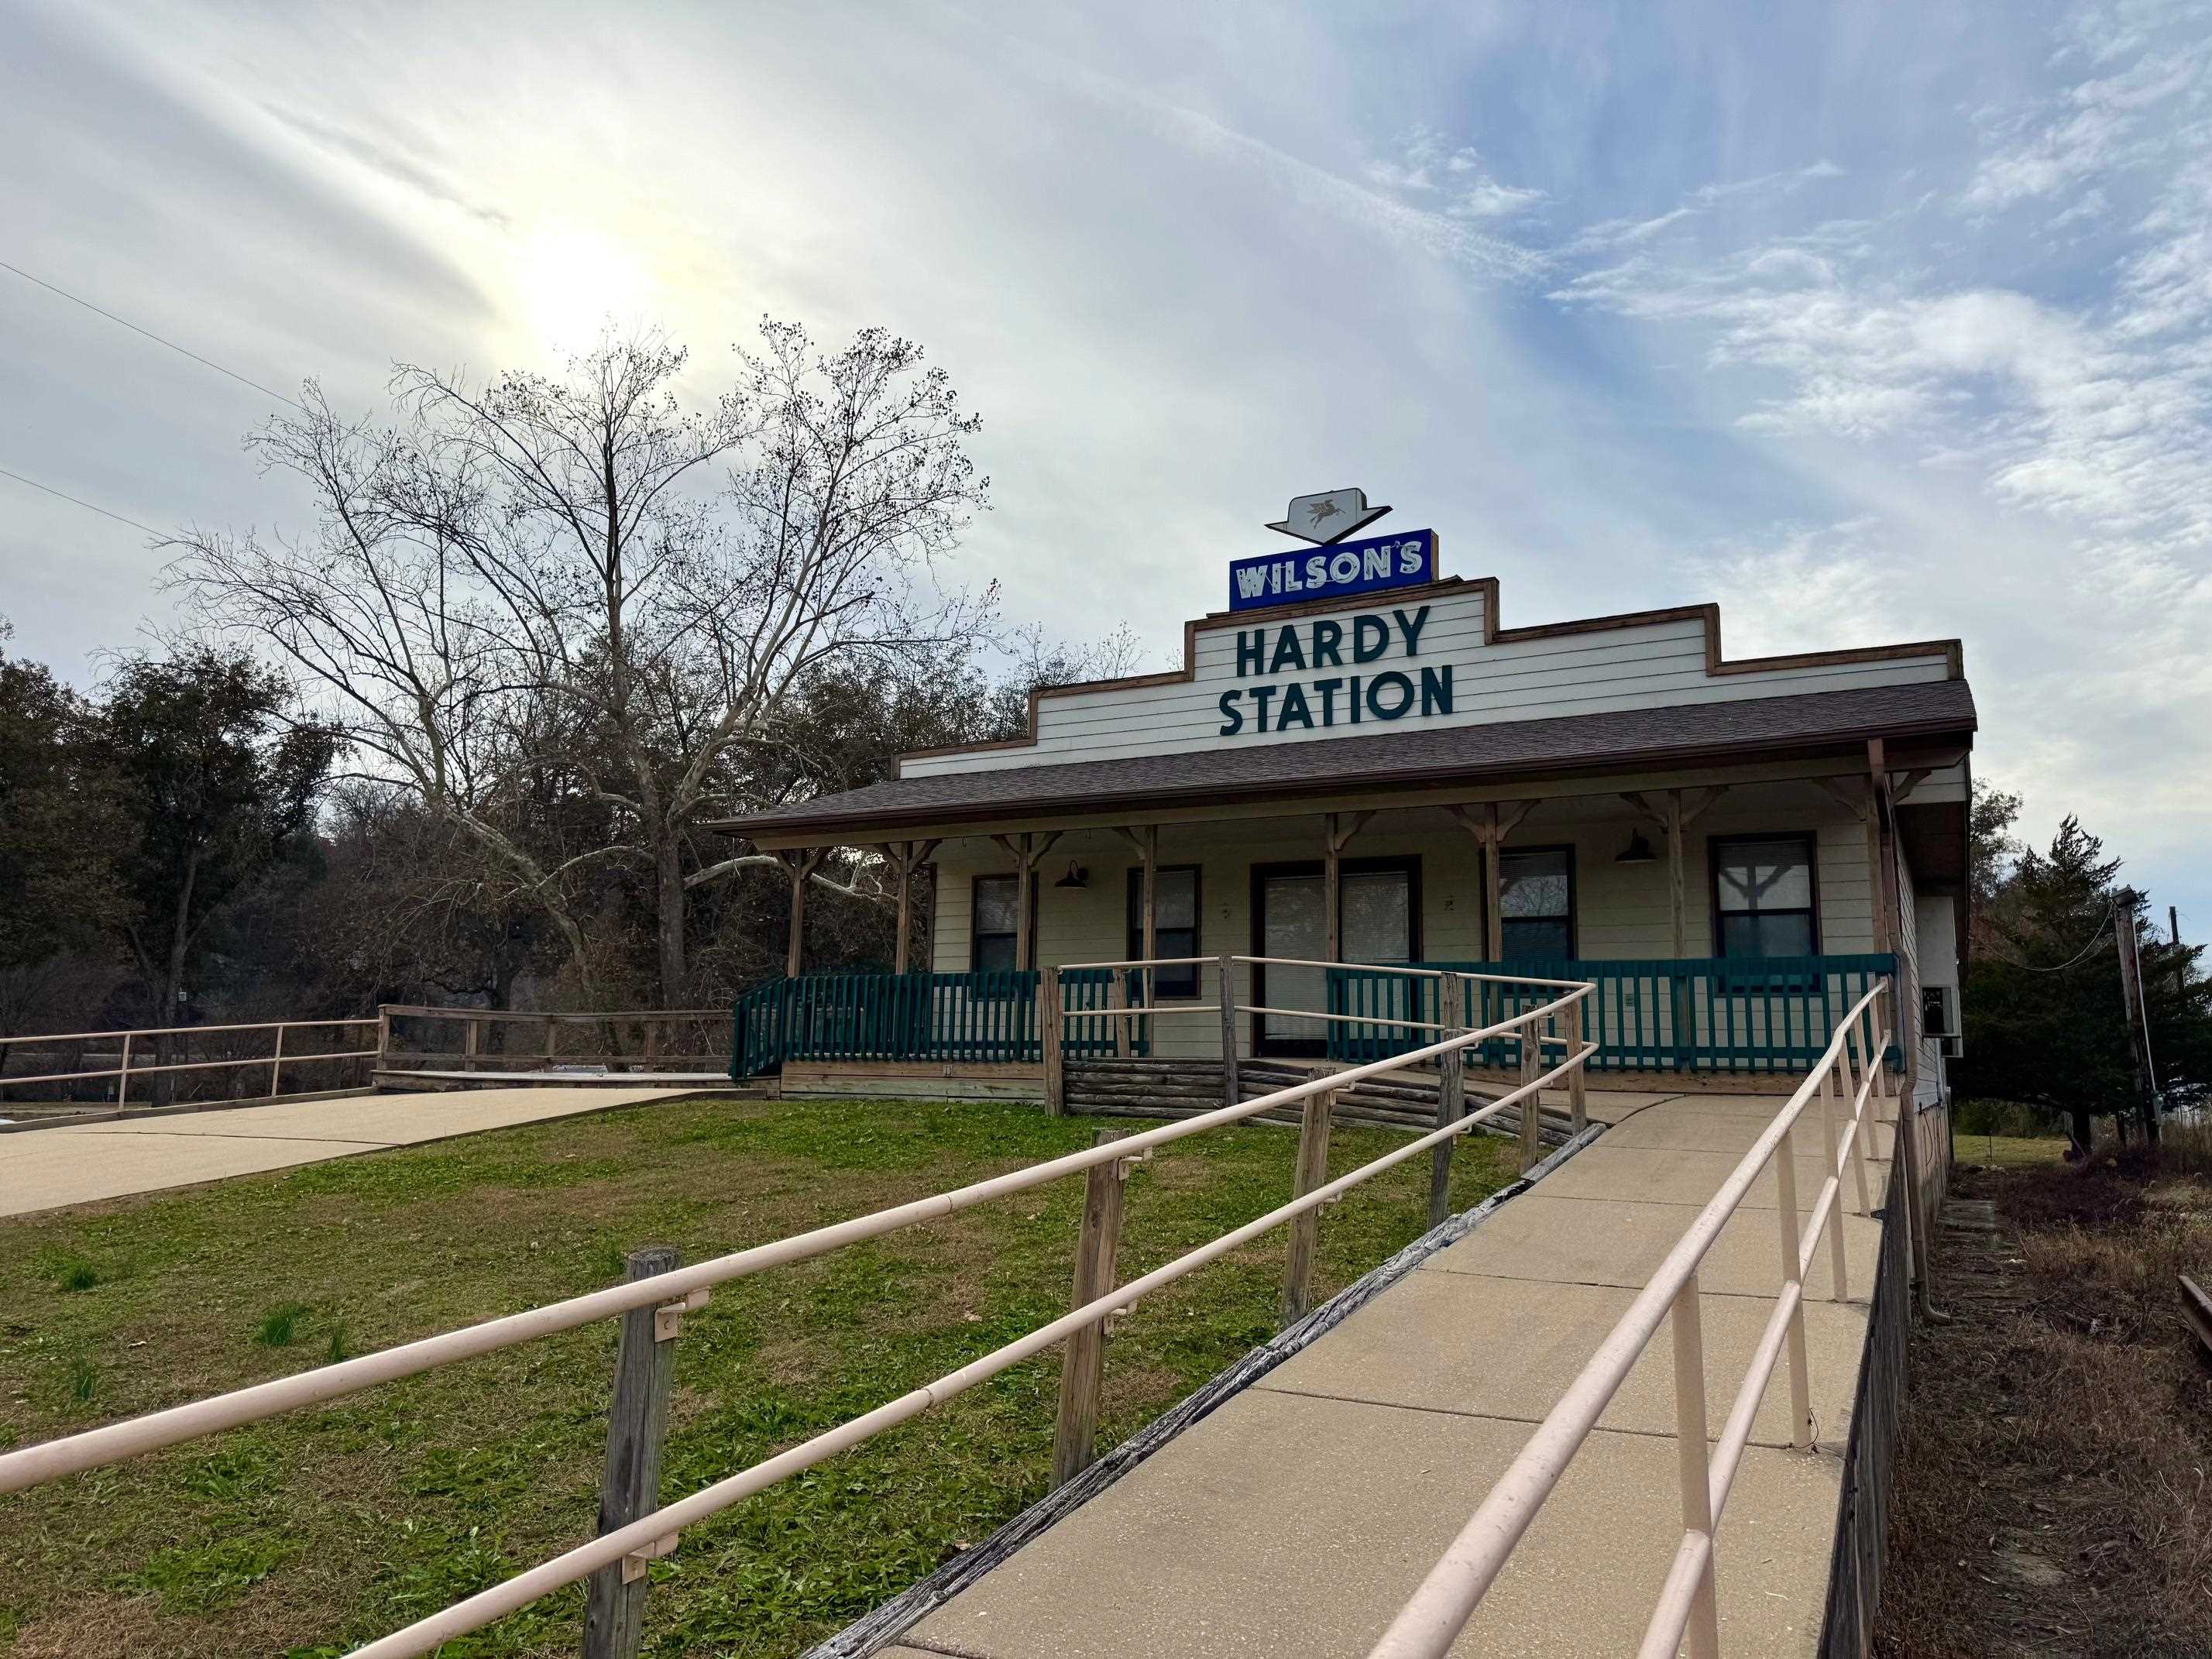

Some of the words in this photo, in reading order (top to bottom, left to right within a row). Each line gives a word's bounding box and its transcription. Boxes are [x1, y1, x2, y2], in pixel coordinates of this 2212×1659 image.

[1236, 541, 1423, 599] WILSON'S
[1236, 606, 1431, 677] HARDY
[1219, 665, 1453, 736] STATION
